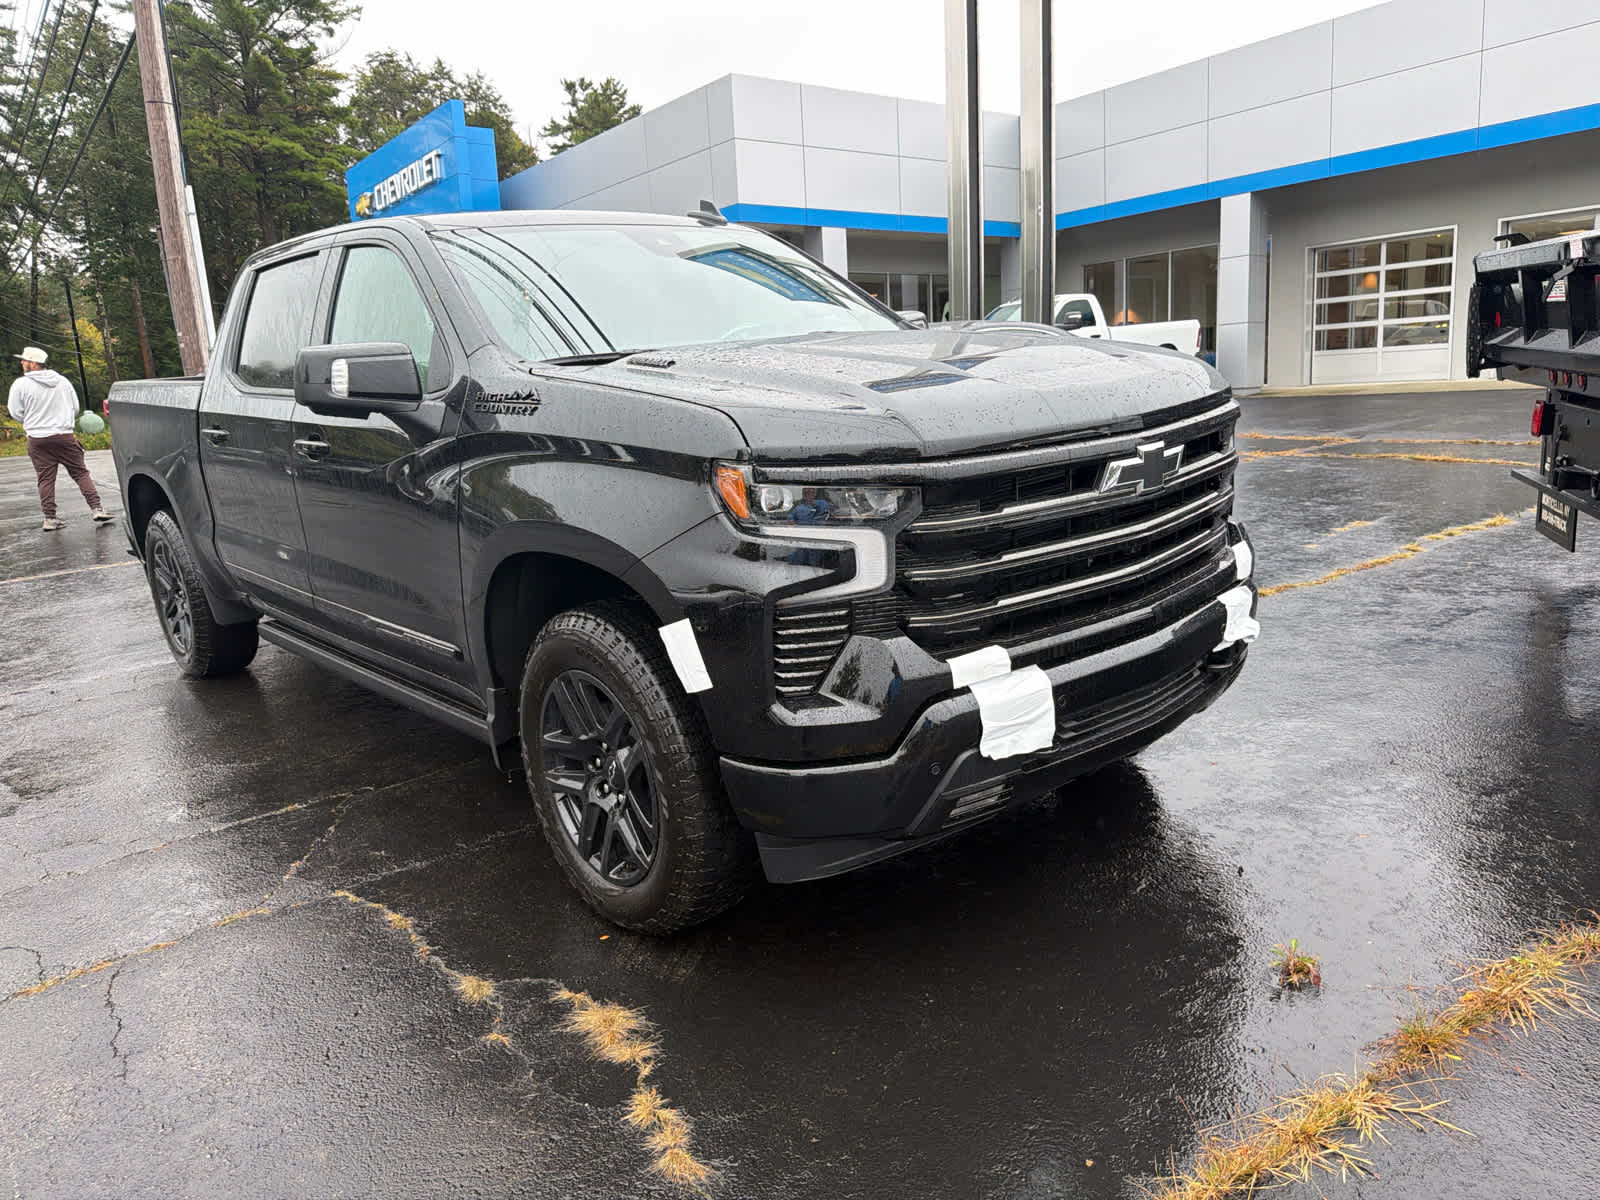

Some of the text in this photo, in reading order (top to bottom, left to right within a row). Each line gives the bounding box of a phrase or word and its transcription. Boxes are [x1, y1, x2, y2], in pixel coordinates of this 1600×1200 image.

[373, 149, 443, 210] CHEVROLET
[475, 391, 505, 403] HIGH
[473, 402, 539, 416] COUNTRY
